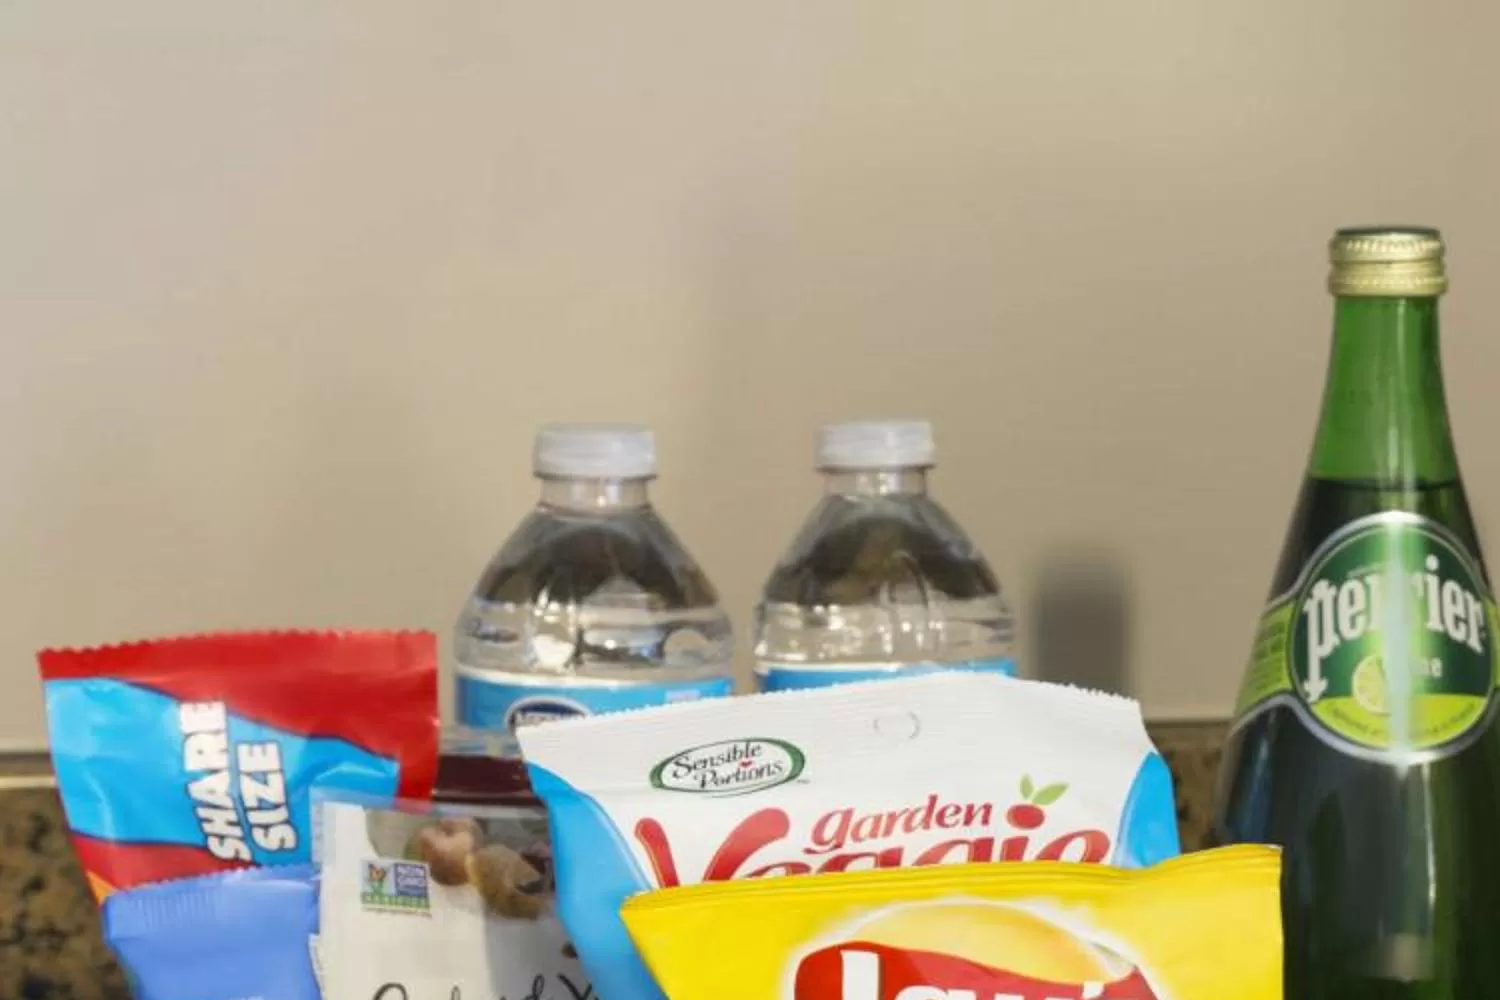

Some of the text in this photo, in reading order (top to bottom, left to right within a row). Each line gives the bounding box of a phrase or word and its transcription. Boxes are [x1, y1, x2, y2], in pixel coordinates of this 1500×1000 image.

[1302, 555, 1485, 702] perier
[179, 701, 254, 862] SHARE
[236, 742, 298, 851] SIZE
[672, 741, 762, 779] Sensible
[693, 760, 783, 788] Portions
[803, 794, 992, 854] garden
